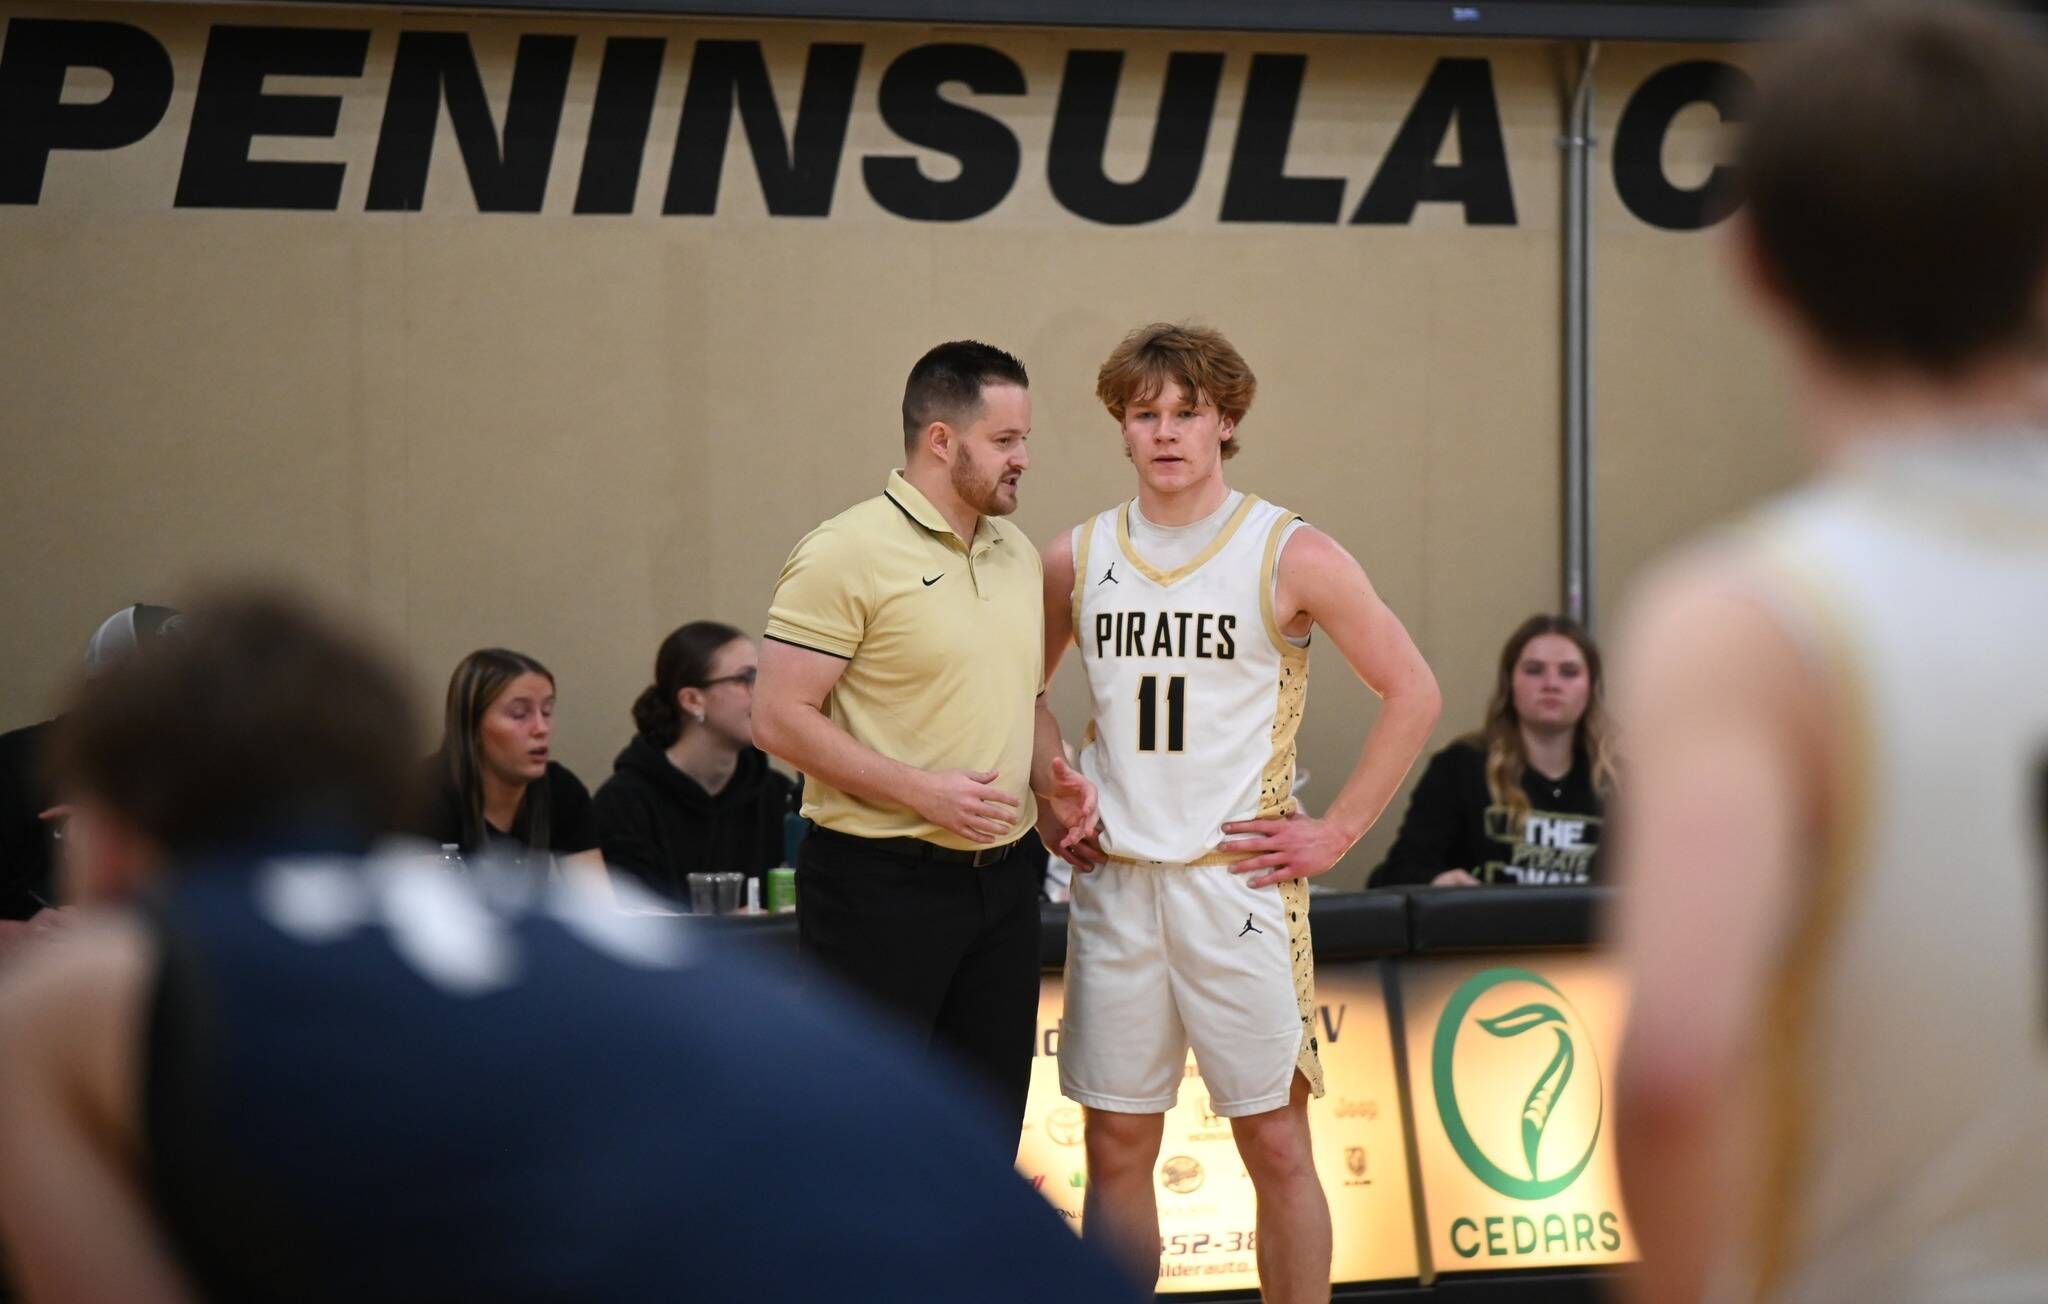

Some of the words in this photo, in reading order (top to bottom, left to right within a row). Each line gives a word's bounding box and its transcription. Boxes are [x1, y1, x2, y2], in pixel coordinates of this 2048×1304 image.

[0, 17, 1518, 226] PENINSULA
[1096, 611, 1237, 660] PIRATES
[1136, 673, 1188, 754] 11
[1524, 816, 1586, 849] THE
[1450, 1211, 1621, 1258] CEDARS
